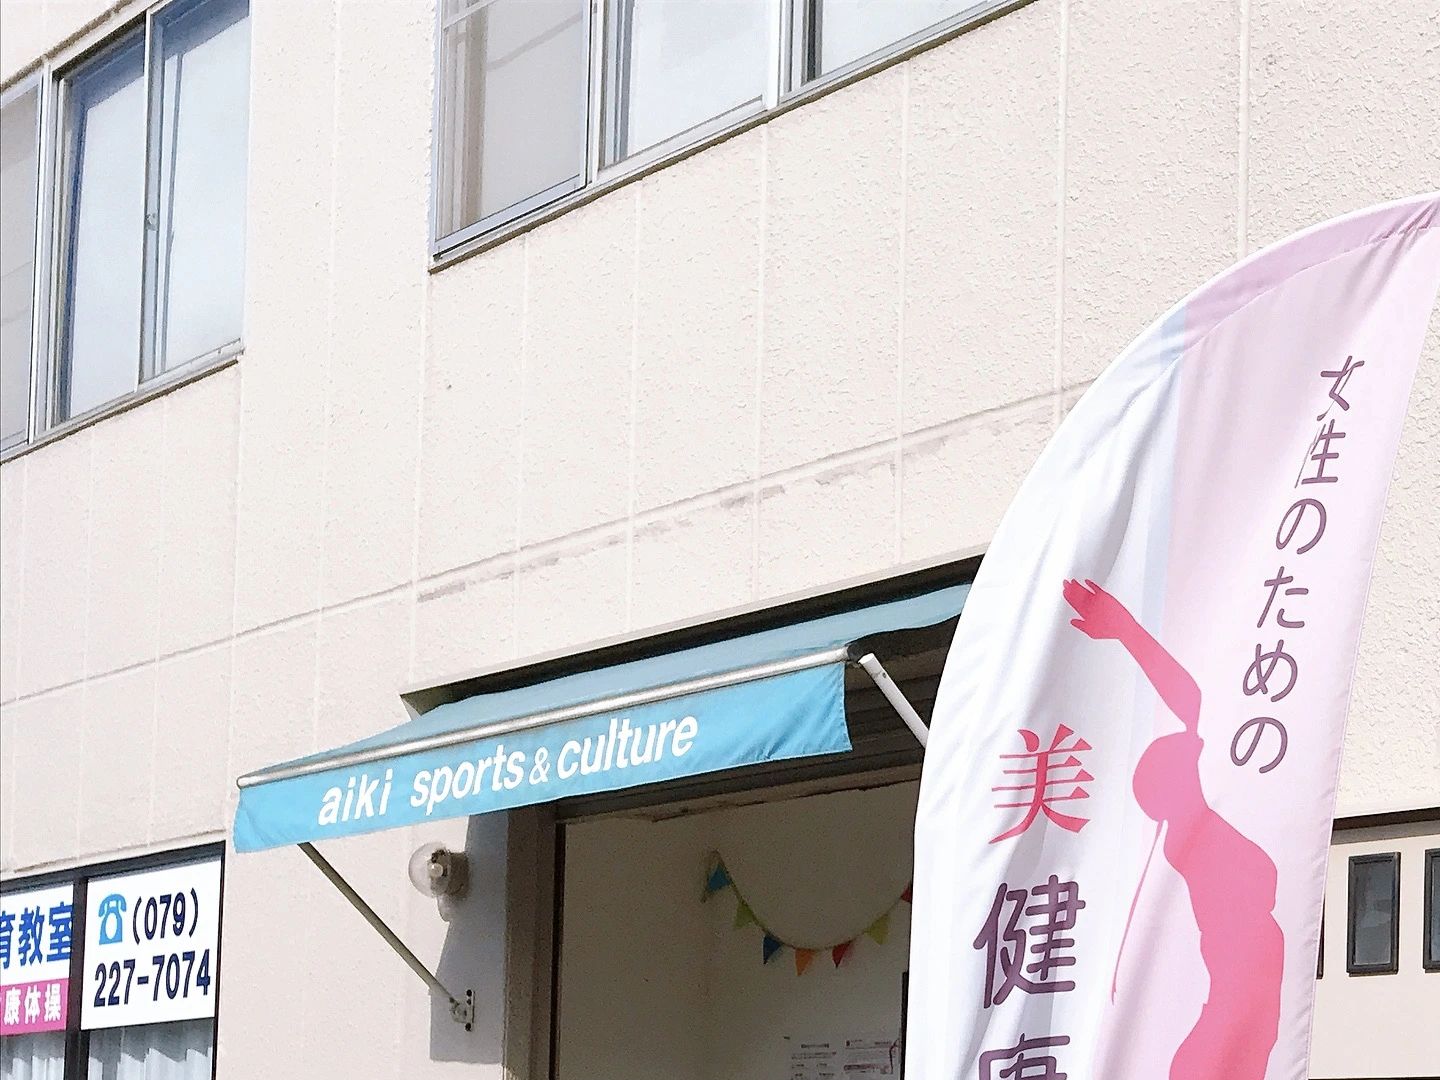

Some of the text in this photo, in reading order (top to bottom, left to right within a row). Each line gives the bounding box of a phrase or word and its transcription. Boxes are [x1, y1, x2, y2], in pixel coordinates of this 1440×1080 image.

[1230, 355, 1365, 774] 女性のための
[318, 714, 699, 825] aiki sports & culture
[133, 887, 199, 945] (079)
[0, 983, 62, 1026] 康体操
[93, 949, 211, 1007] 227-7074
